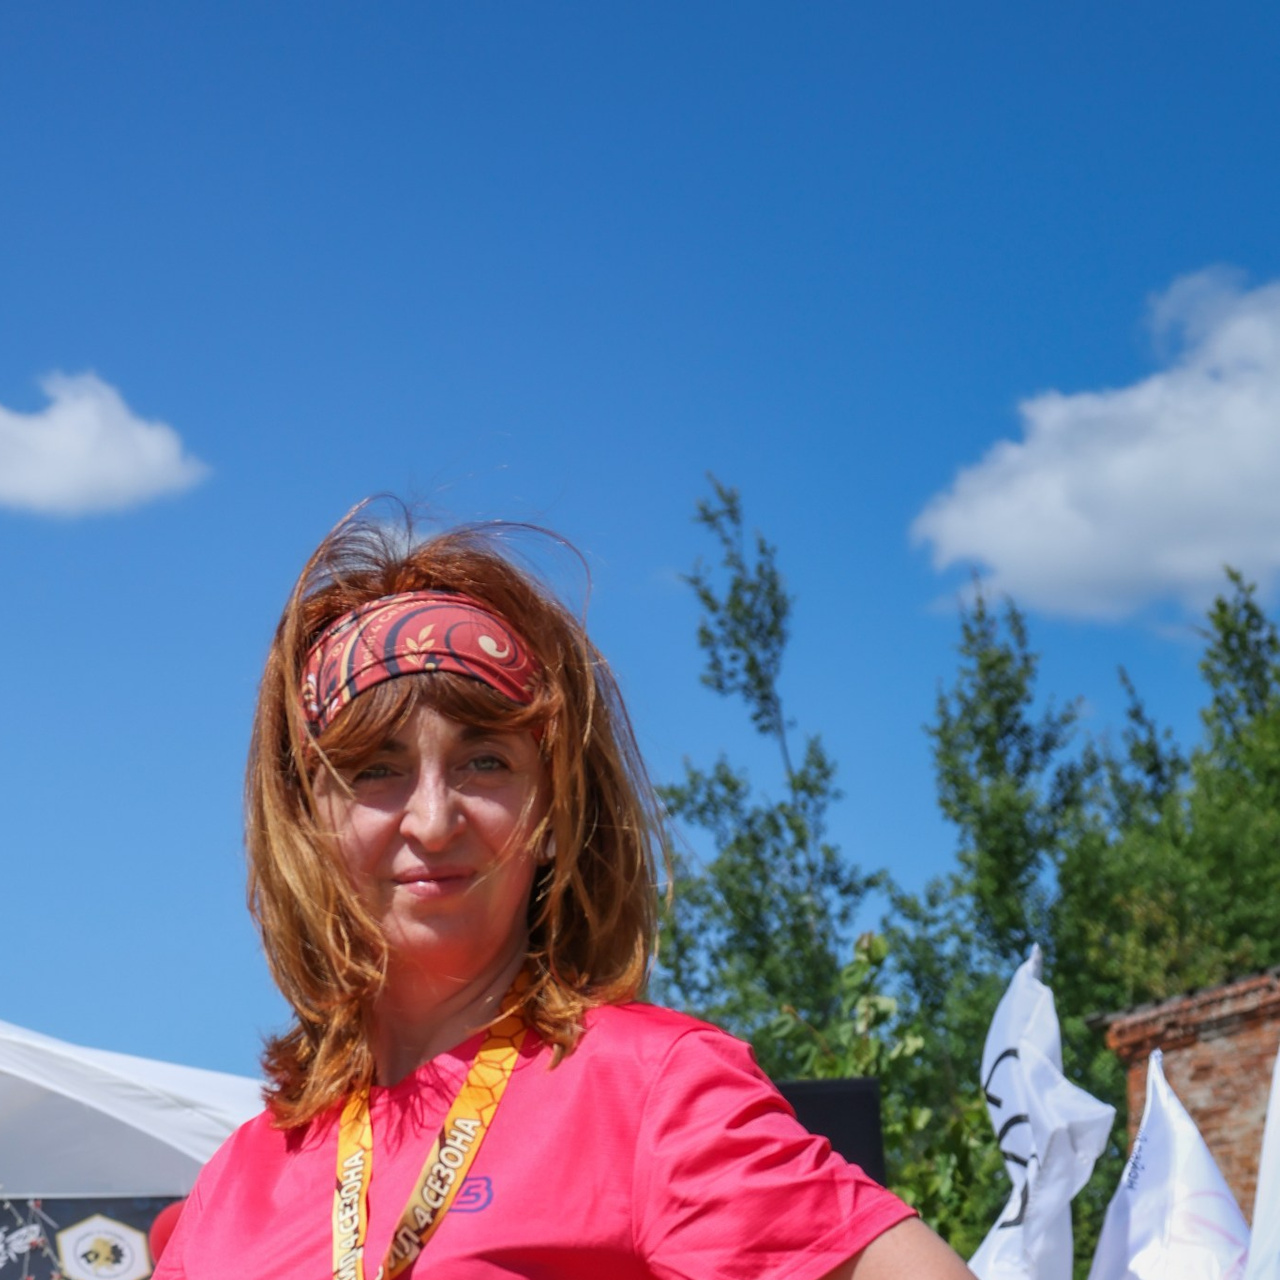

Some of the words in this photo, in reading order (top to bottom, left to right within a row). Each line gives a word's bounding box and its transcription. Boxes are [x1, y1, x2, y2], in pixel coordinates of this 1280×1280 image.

[422, 1117, 482, 1209] СЕЗОНА
[339, 1149, 365, 1234] СЕЗОНА
[412, 1207, 434, 1229] 4
[340, 1233, 360, 1249] 4
